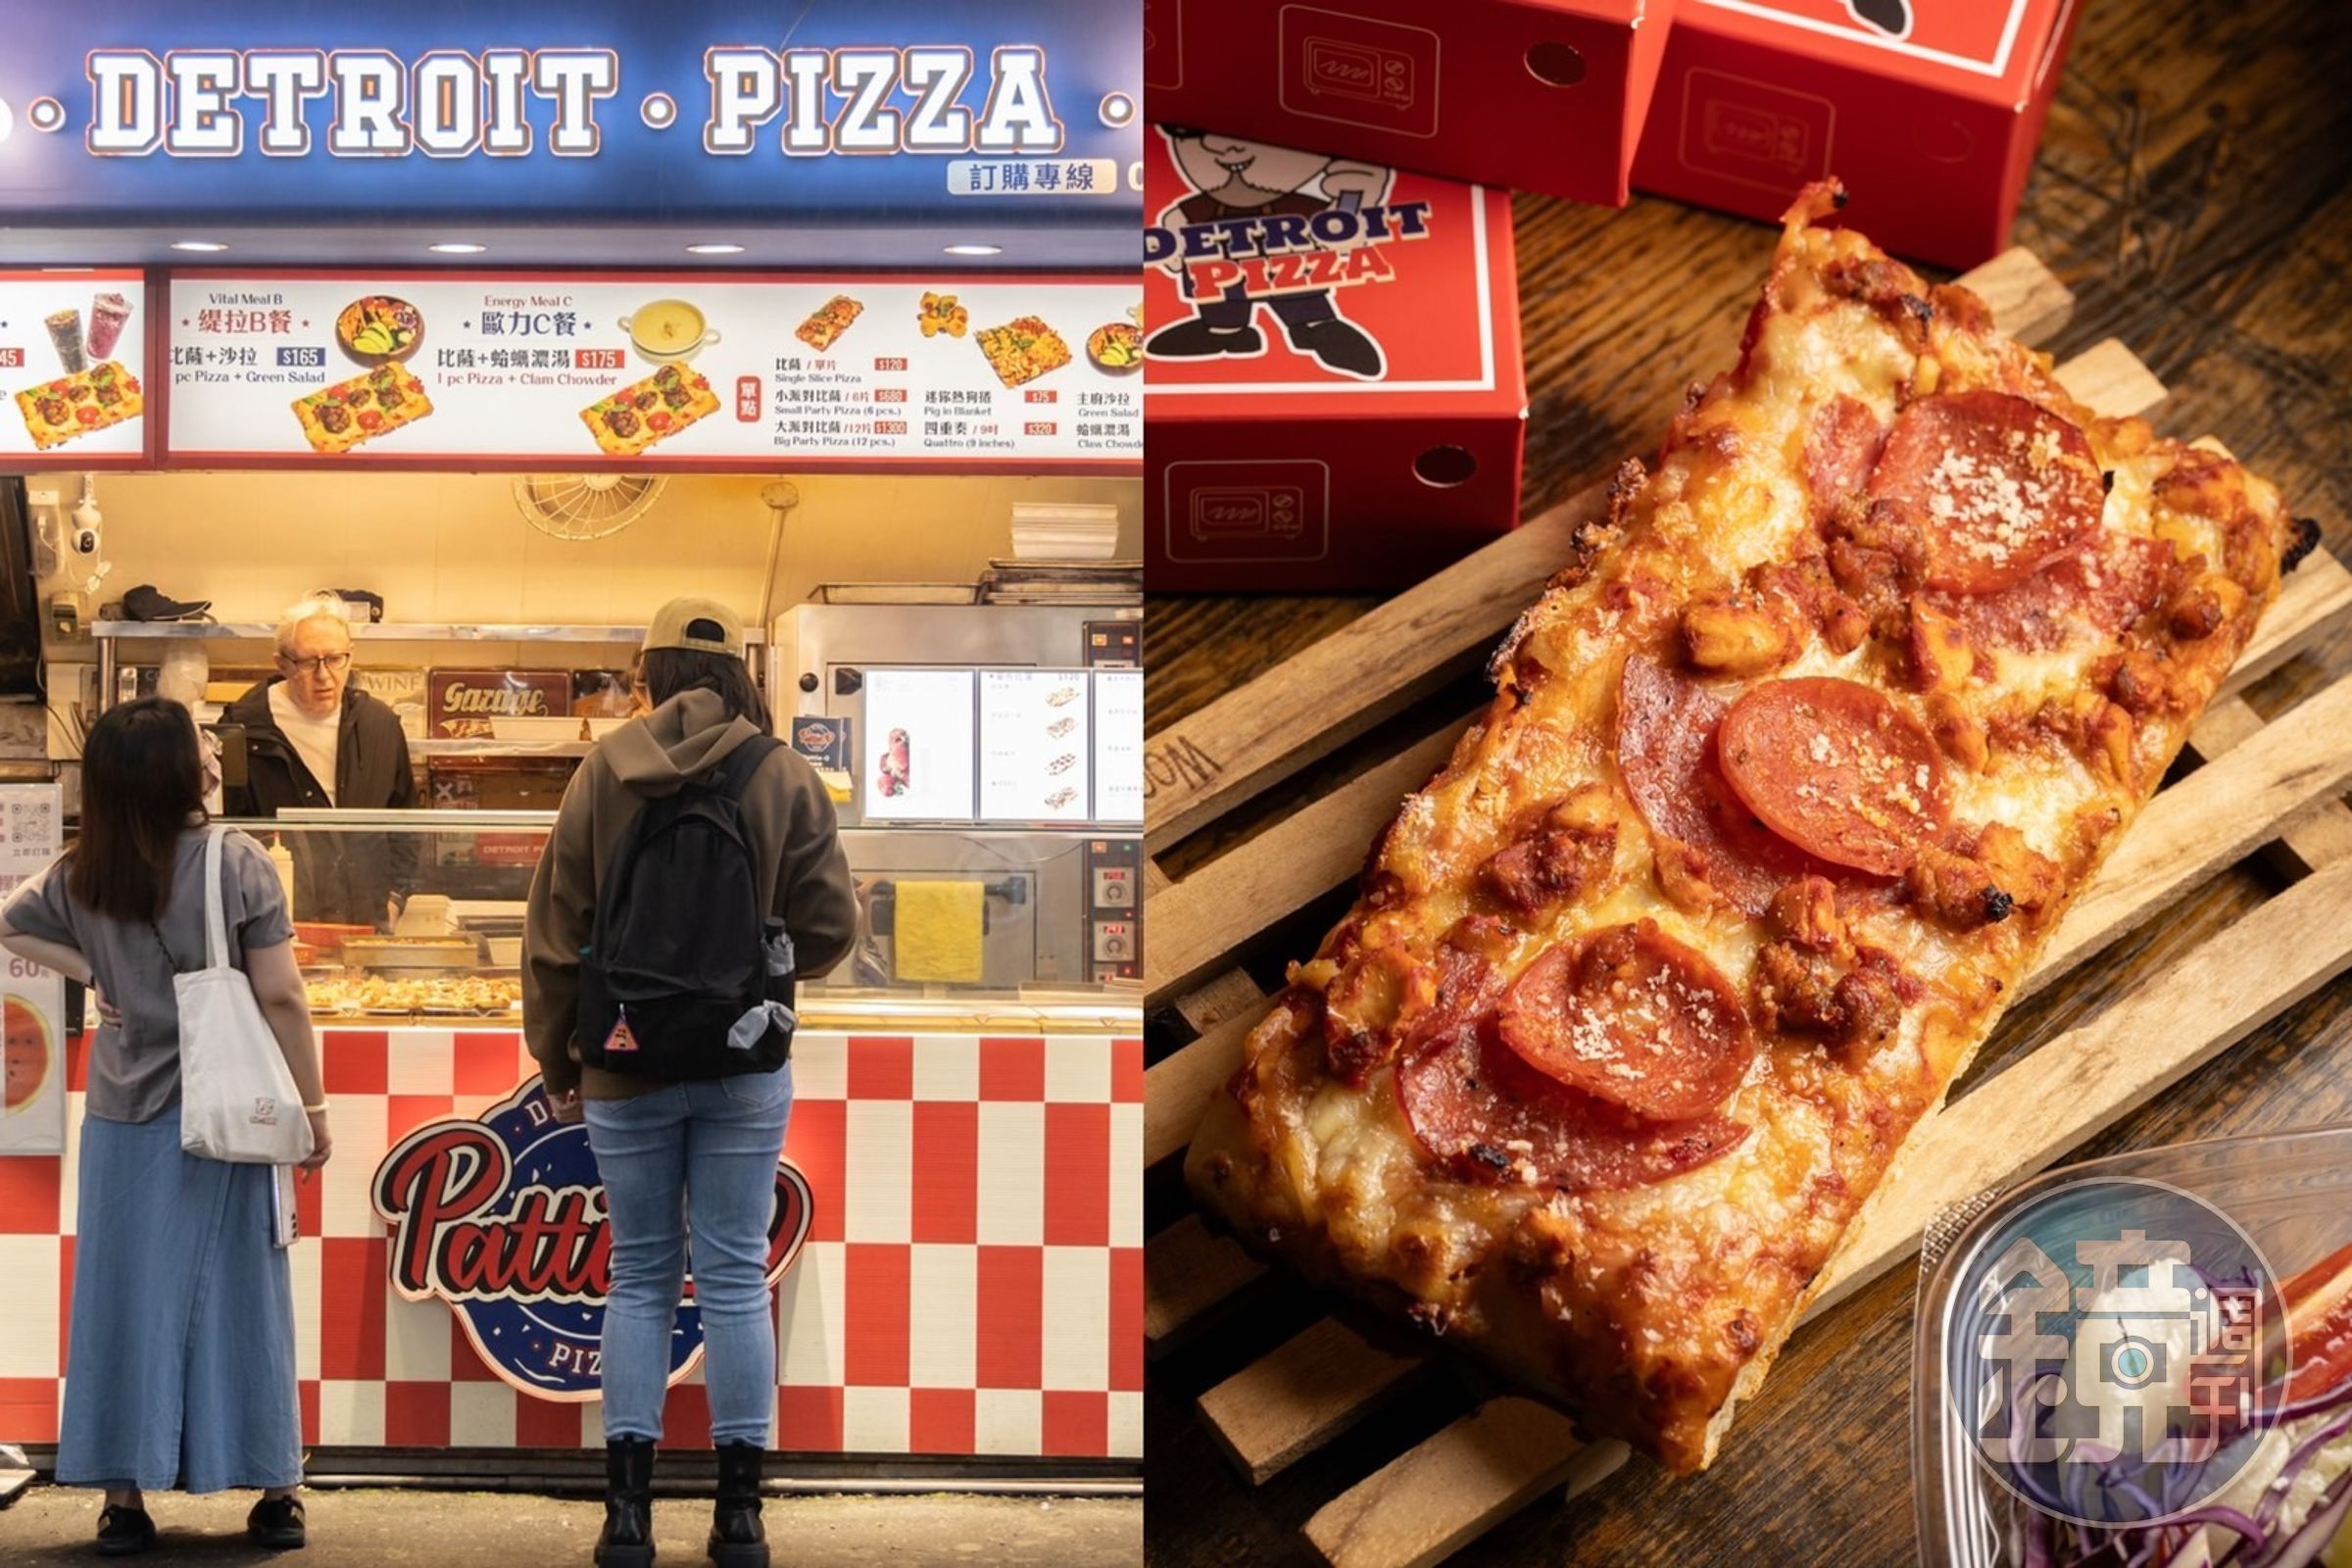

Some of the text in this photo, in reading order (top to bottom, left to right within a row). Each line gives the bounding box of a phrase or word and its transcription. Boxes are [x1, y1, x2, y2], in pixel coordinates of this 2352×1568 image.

[86, 46, 1064, 157] DETROIT PIZZA
[968, 163, 1095, 191] 訂購專線
[1144, 200, 1431, 265] DETROIT
[1189, 242, 1396, 304] PIZZA
[209, 294, 283, 305] Vital Meal B
[484, 296, 573, 309] Energy Meal C
[481, 312, 576, 336] 歐力C餐
[282, 349, 318, 366] $165
[437, 349, 616, 368] 比薩+蛤蠣濃湯 $175
[175, 373, 191, 384] pc
[195, 371, 229, 382] Pizza
[246, 371, 284, 383] Green
[288, 372, 325, 383] Salad
[447, 375, 464, 387] pc
[467, 373, 503, 385] Pizza
[519, 373, 554, 385] Clam
[557, 374, 617, 385] Chowder
[775, 374, 861, 384] Single Slice Pizza
[774, 406, 802, 415] Small
[804, 406, 831, 416] Party
[834, 406, 860, 415] Pizza
[924, 407, 992, 417] Pig in Blanket
[1078, 409, 1140, 417] Green Salad
[774, 436, 791, 447] Big
[792, 436, 819, 447] Party
[924, 439, 964, 448] Quattro
[548, 1342, 604, 1376] PIZ
